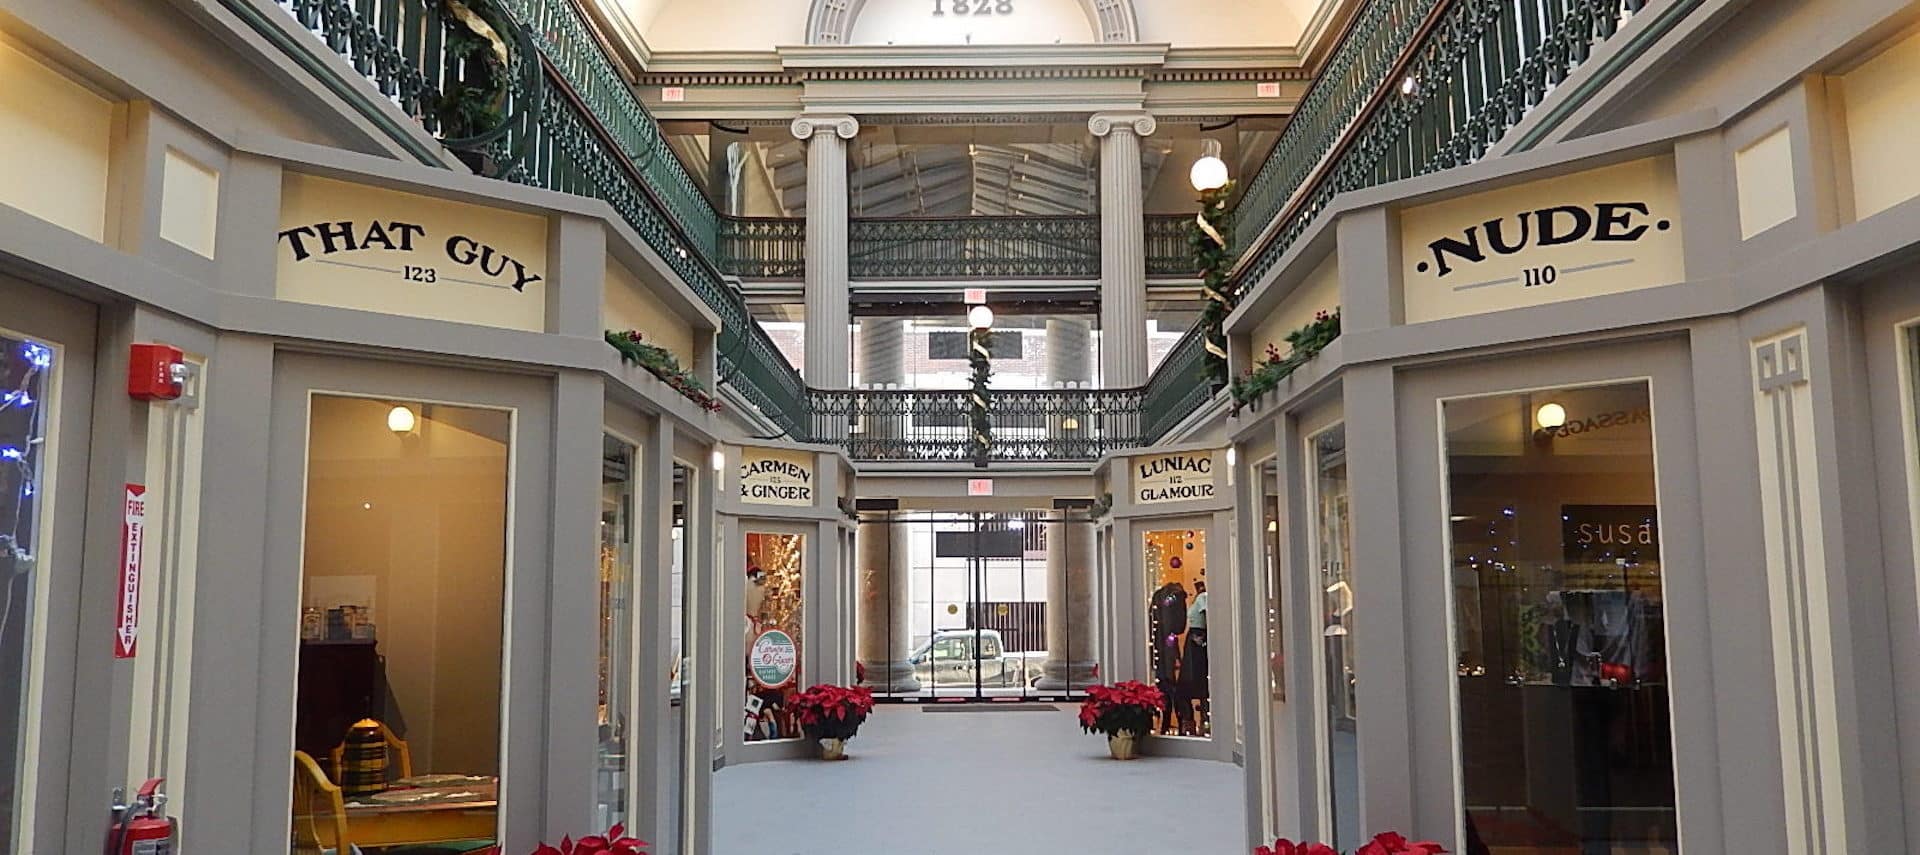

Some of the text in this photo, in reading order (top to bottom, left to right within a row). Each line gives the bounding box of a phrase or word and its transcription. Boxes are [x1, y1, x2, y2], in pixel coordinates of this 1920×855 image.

[932, 0, 1014, 16] 1828
[278, 220, 542, 293] THAT GUY
[403, 265, 437, 283] 123
[1523, 265, 1556, 287] 110
[1140, 456, 1211, 479] LUNIAC
[752, 485, 811, 500] GINGER
[1140, 484, 1214, 501] GLAMOUR
[128, 501, 145, 516] FIRE
[124, 522, 139, 645] EXTINGUISHER
